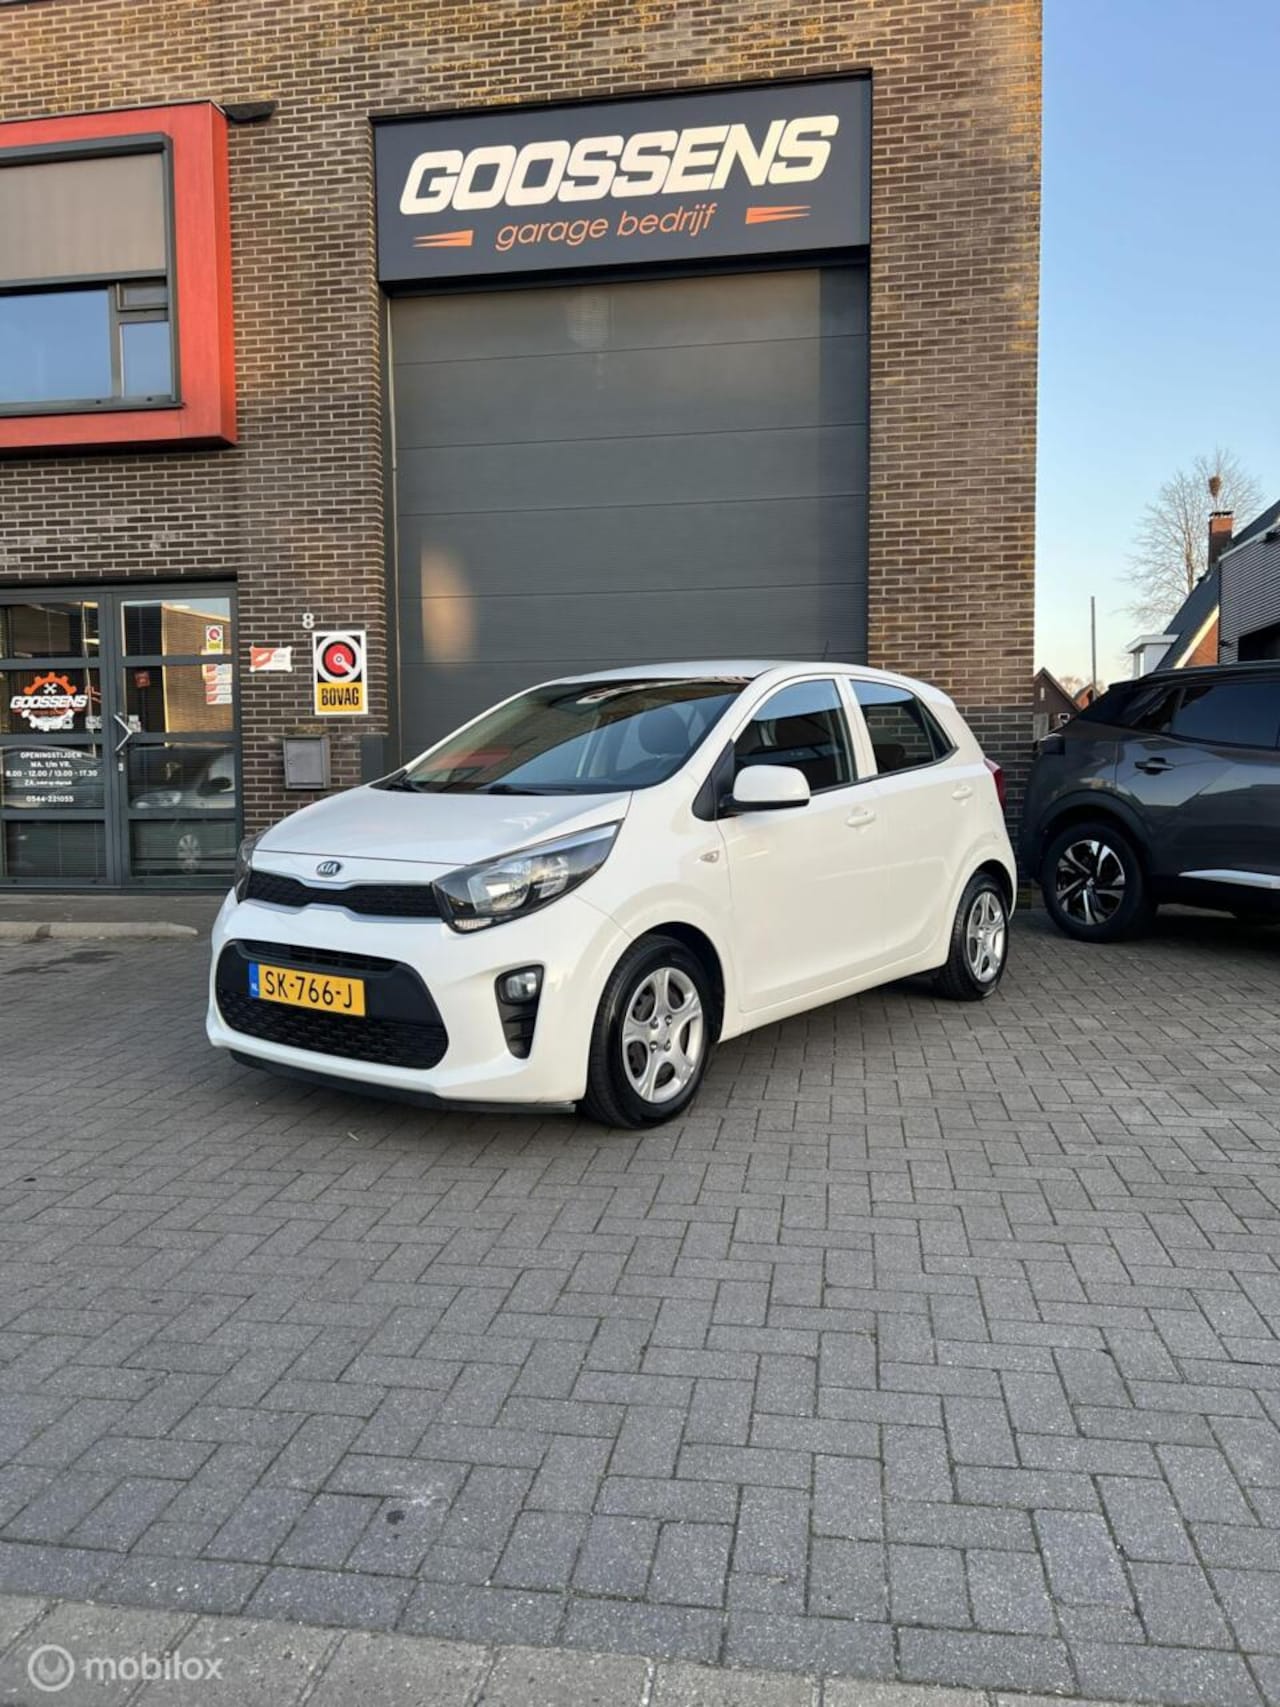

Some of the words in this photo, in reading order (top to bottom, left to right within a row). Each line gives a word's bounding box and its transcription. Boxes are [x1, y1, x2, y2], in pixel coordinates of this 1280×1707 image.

[399, 114, 840, 216] GOOSSENS
[495, 214, 609, 252] garage
[617, 203, 718, 237] bedrijf
[302, 612, 315, 629] 8
[10, 695, 88, 709] GOOSSENS
[321, 687, 360, 706] BOVAG
[265, 970, 353, 1009] SK-766-J
